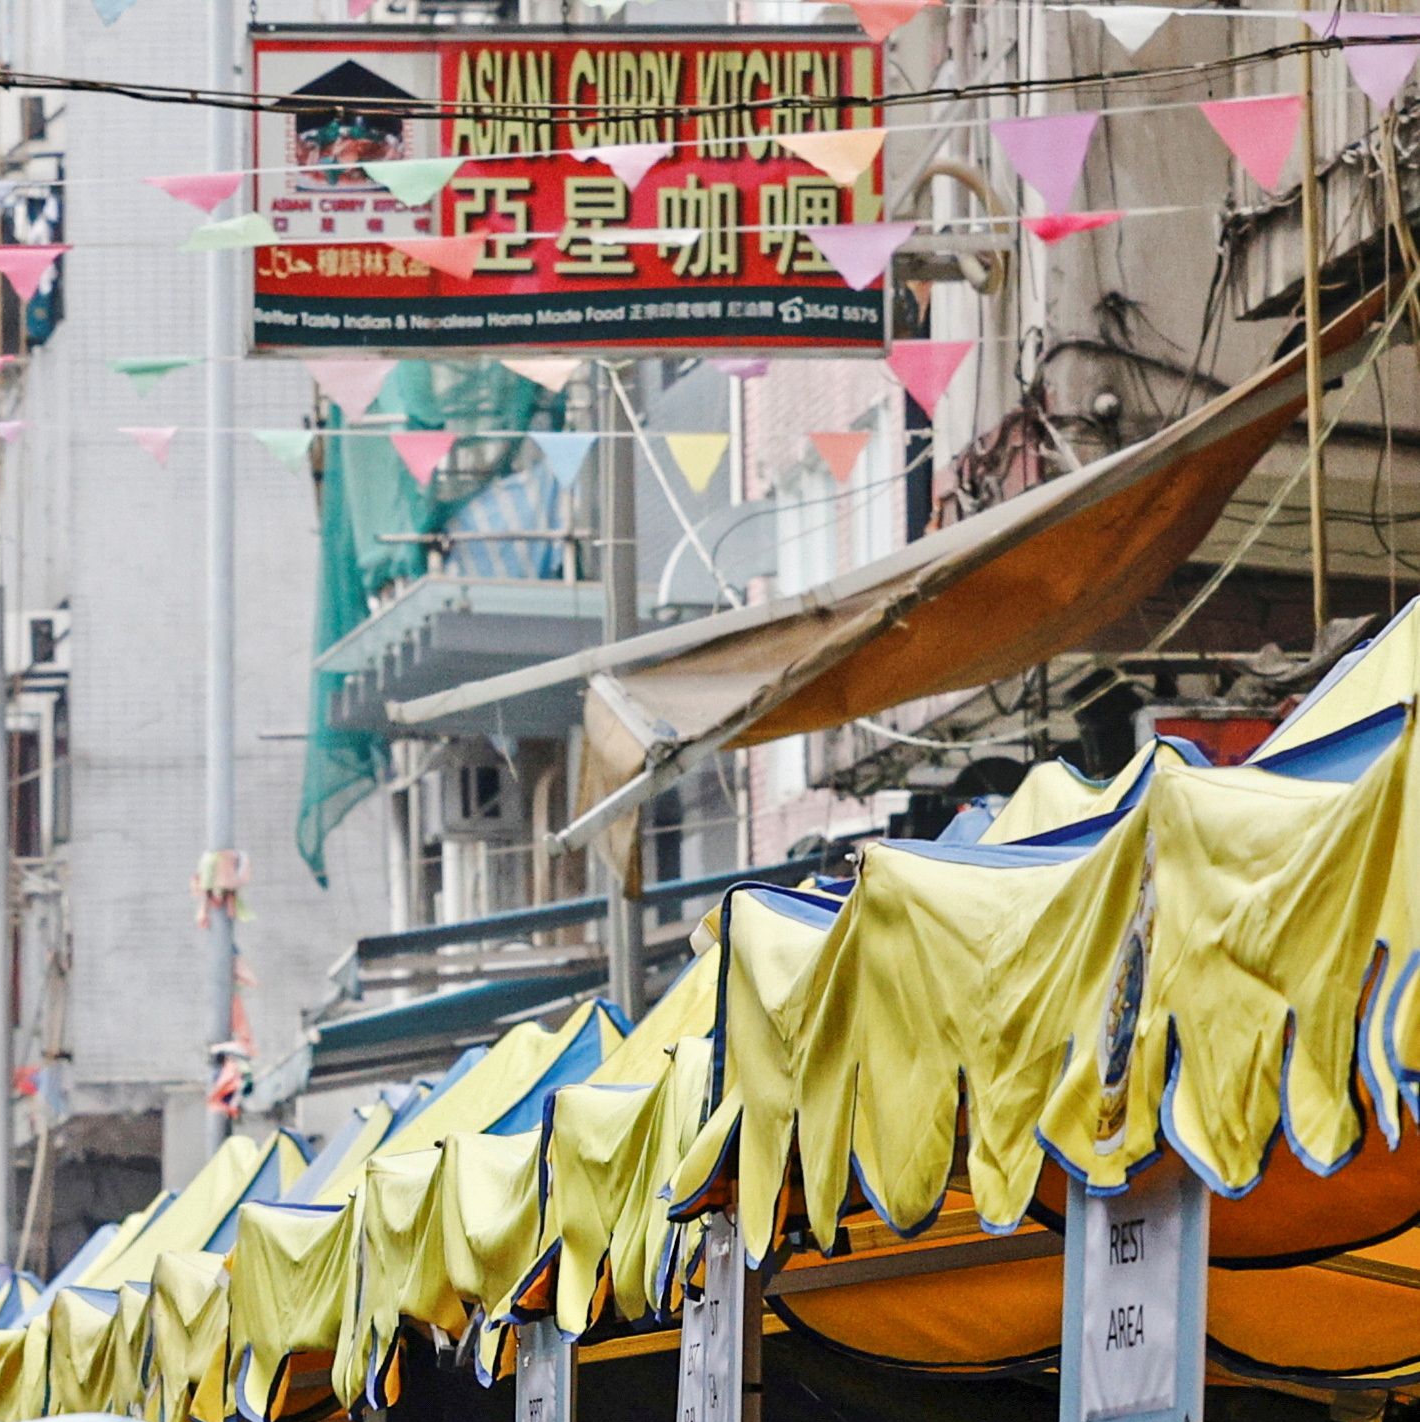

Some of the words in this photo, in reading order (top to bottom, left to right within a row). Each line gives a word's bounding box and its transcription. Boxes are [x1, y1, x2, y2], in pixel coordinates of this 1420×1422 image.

[452, 49, 551, 157] ASIAN
[568, 49, 681, 158] CURRY
[696, 50, 839, 160] KITCHEN
[448, 173, 838, 276] 亞星咖喱
[487, 312, 534, 328] Home
[536, 308, 583, 325] Made
[585, 305, 626, 323] Food
[1109, 1218, 1145, 1266] REST
[1105, 1303, 1145, 1352] AREA
